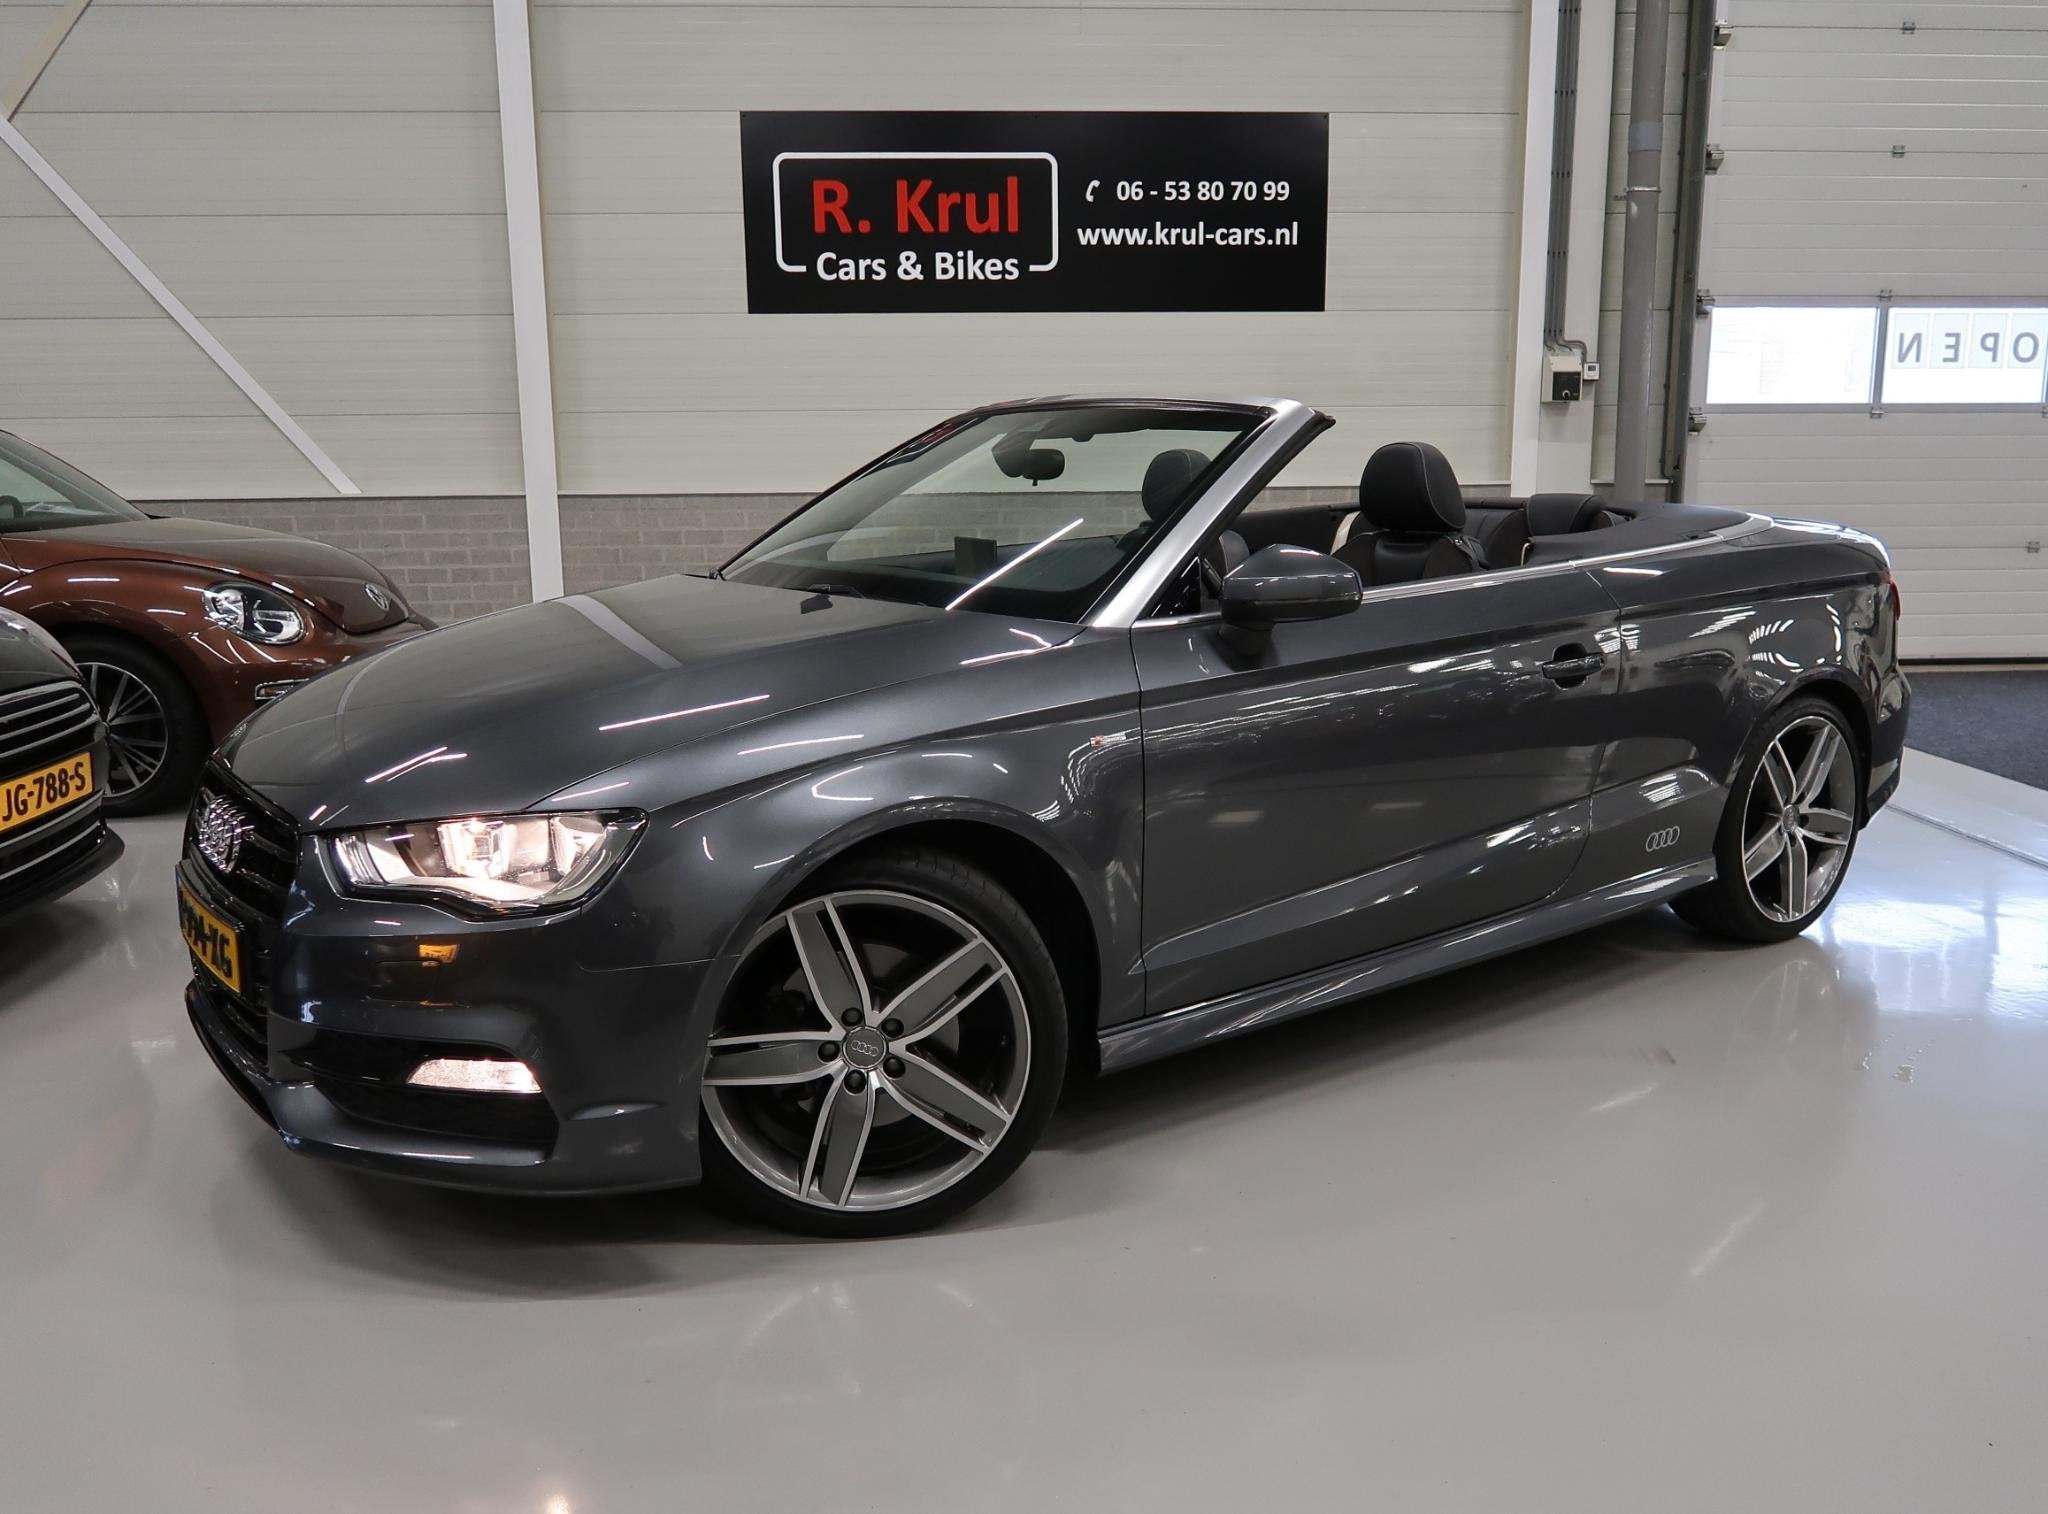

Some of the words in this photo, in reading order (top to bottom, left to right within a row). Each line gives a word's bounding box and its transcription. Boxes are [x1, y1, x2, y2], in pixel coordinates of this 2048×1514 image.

[812, 179, 871, 234] R.
[896, 175, 1019, 234] Krul
[1116, 180, 1144, 202] 06
[1164, 180, 1191, 202] 53
[1197, 180, 1225, 202] 80
[1230, 180, 1258, 202] 70
[1263, 180, 1290, 202] 99
[1076, 220, 1299, 247] www.krul-cars.nl
[816, 251, 887, 281] Cars
[896, 250, 925, 281] &
[934, 250, 1020, 281] Bikes
[2, 761, 86, 822] JG-788-S
